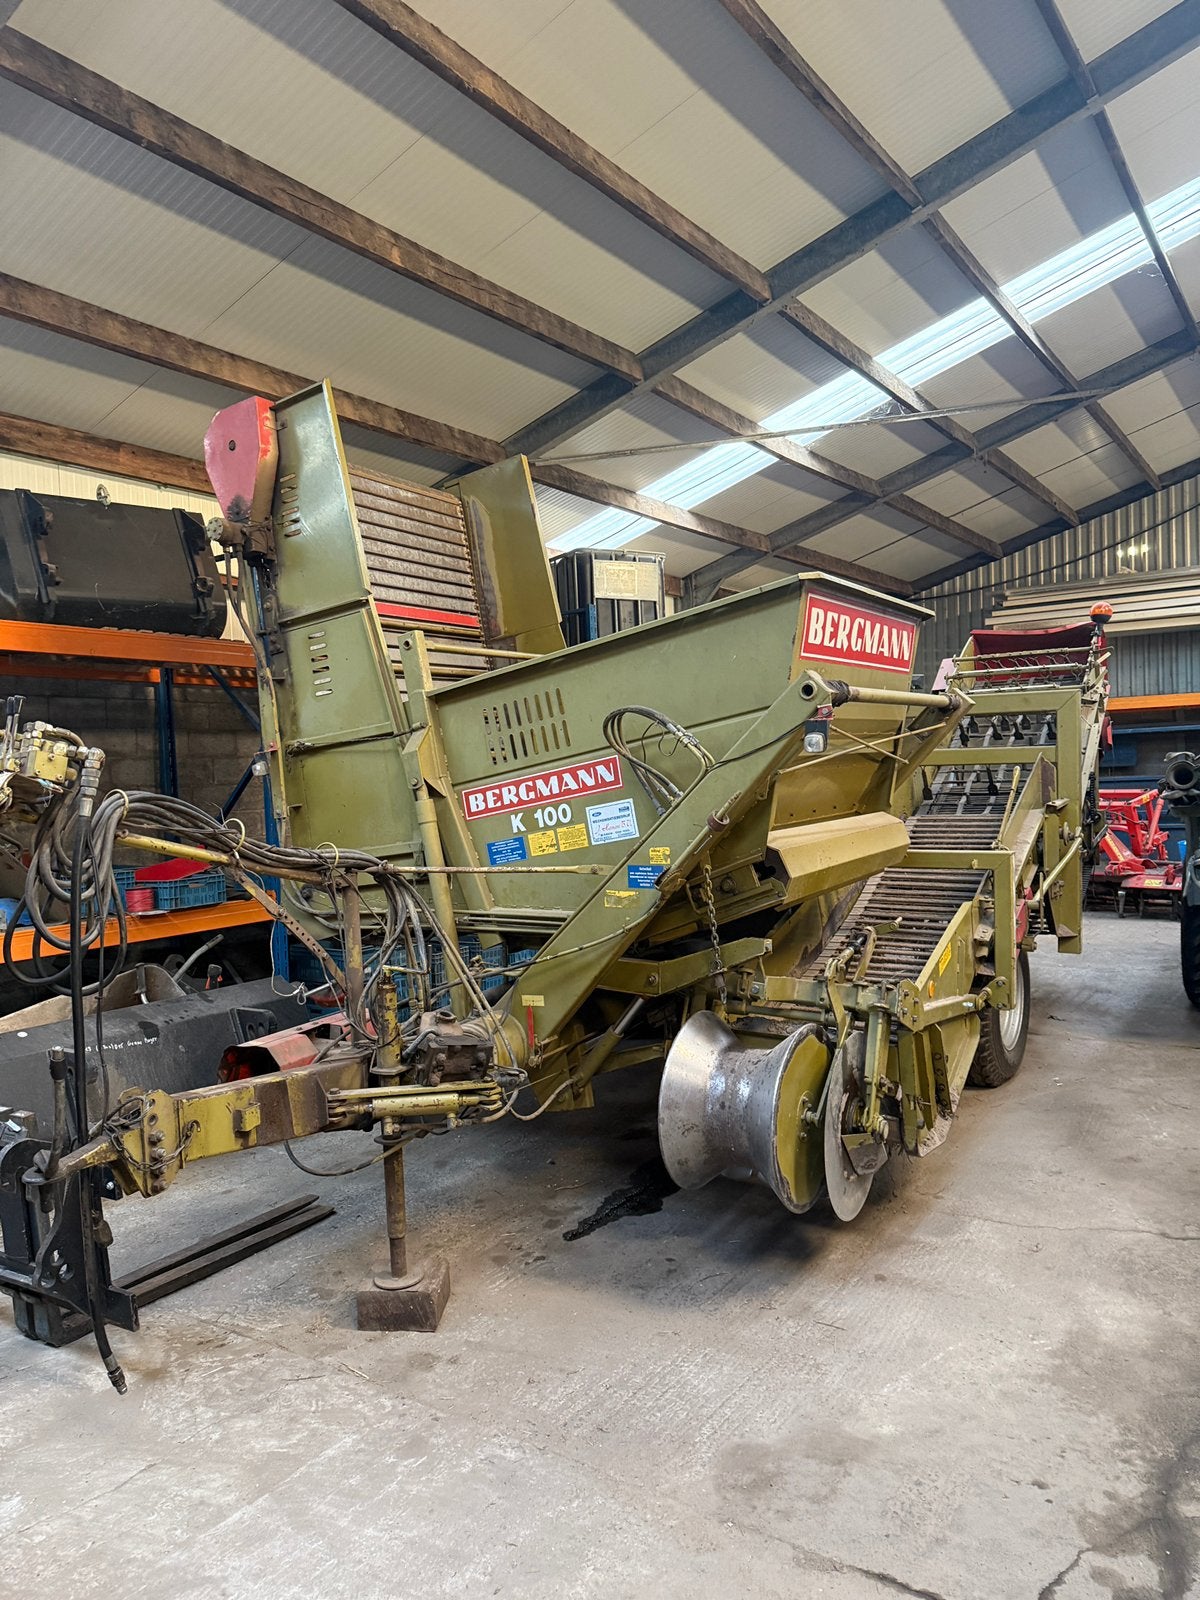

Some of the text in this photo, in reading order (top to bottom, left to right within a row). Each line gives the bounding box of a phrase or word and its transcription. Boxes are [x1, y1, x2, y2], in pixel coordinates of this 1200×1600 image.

[808, 607, 912, 661] BERGMANN
[468, 763, 615, 812] BERGMANN
[511, 812, 526, 834] K
[534, 803, 572, 828] 100
